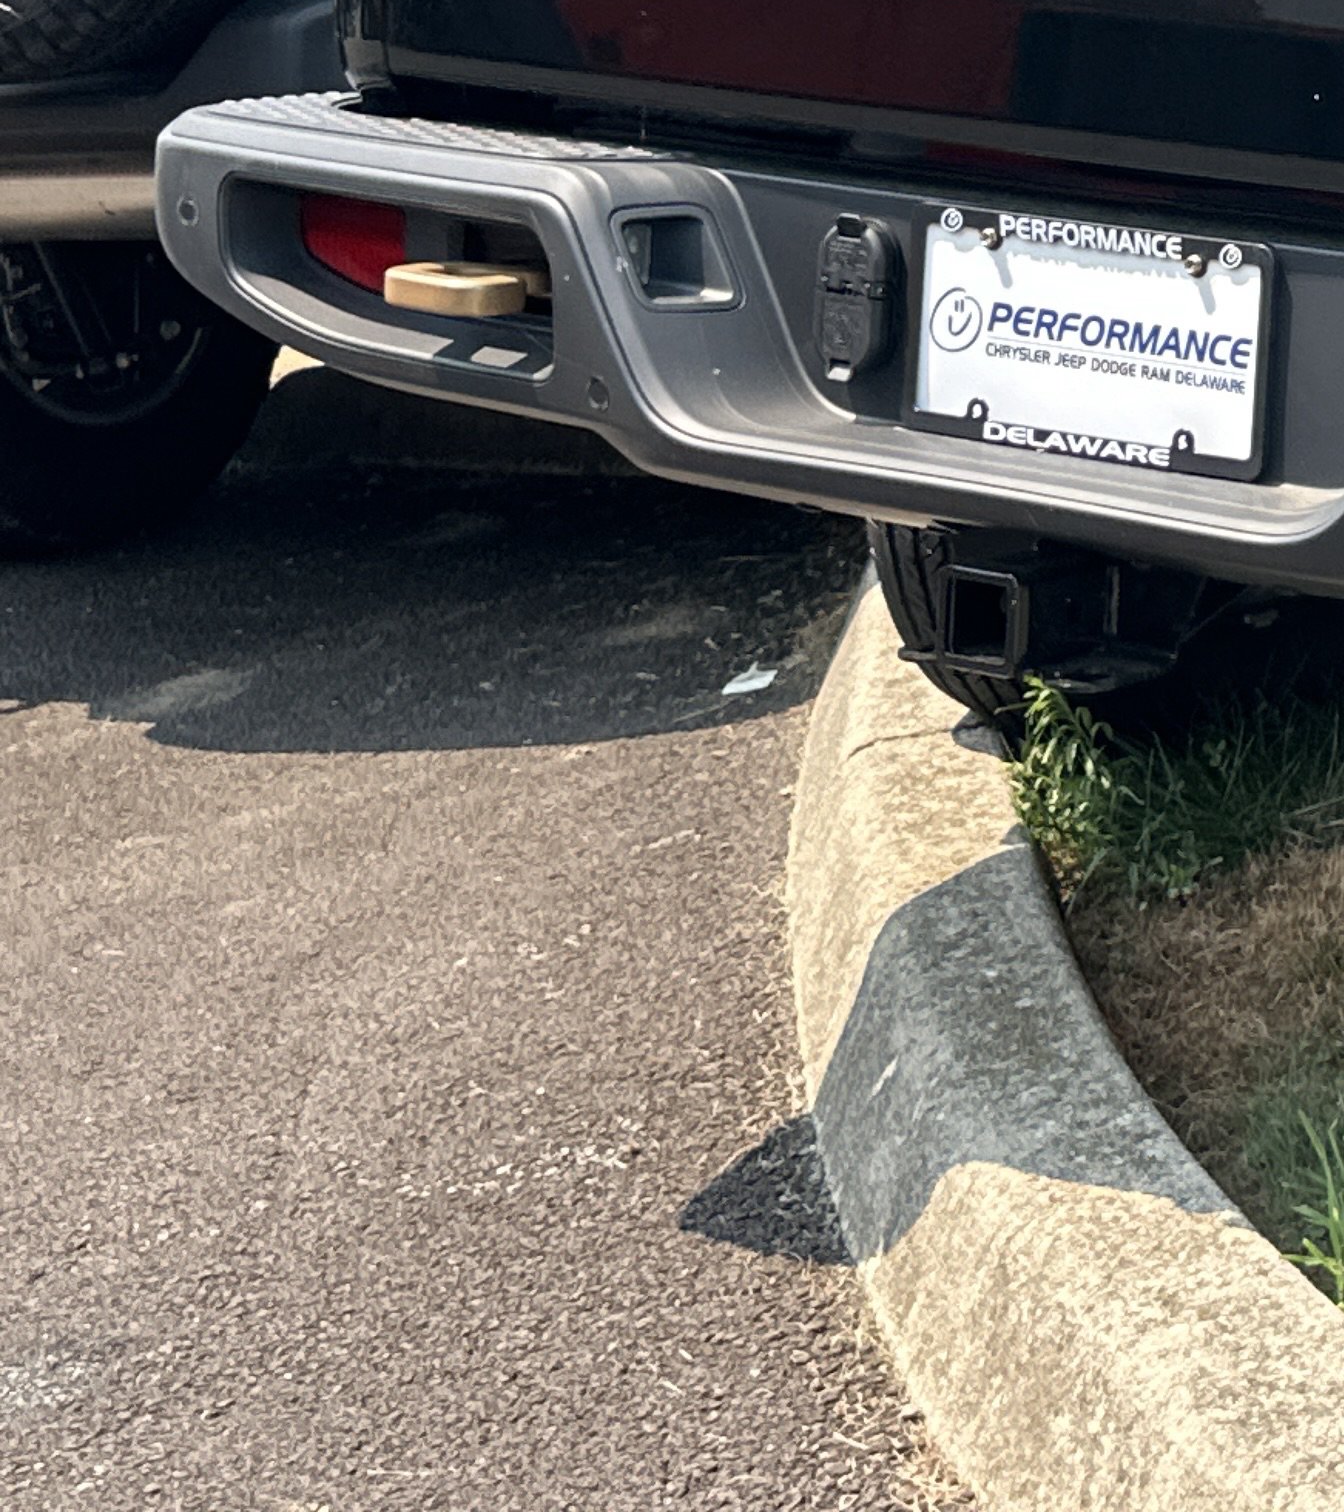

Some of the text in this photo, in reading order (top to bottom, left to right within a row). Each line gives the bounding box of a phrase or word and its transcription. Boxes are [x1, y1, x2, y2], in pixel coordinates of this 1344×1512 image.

[999, 214, 1184, 261] PERFORMANCE
[987, 302, 1254, 370] PERFORMANCE
[985, 342, 1246, 395] CHRYSLER JEEP DODGE RAM DELAWARE
[982, 420, 1171, 467] DELAWARE
